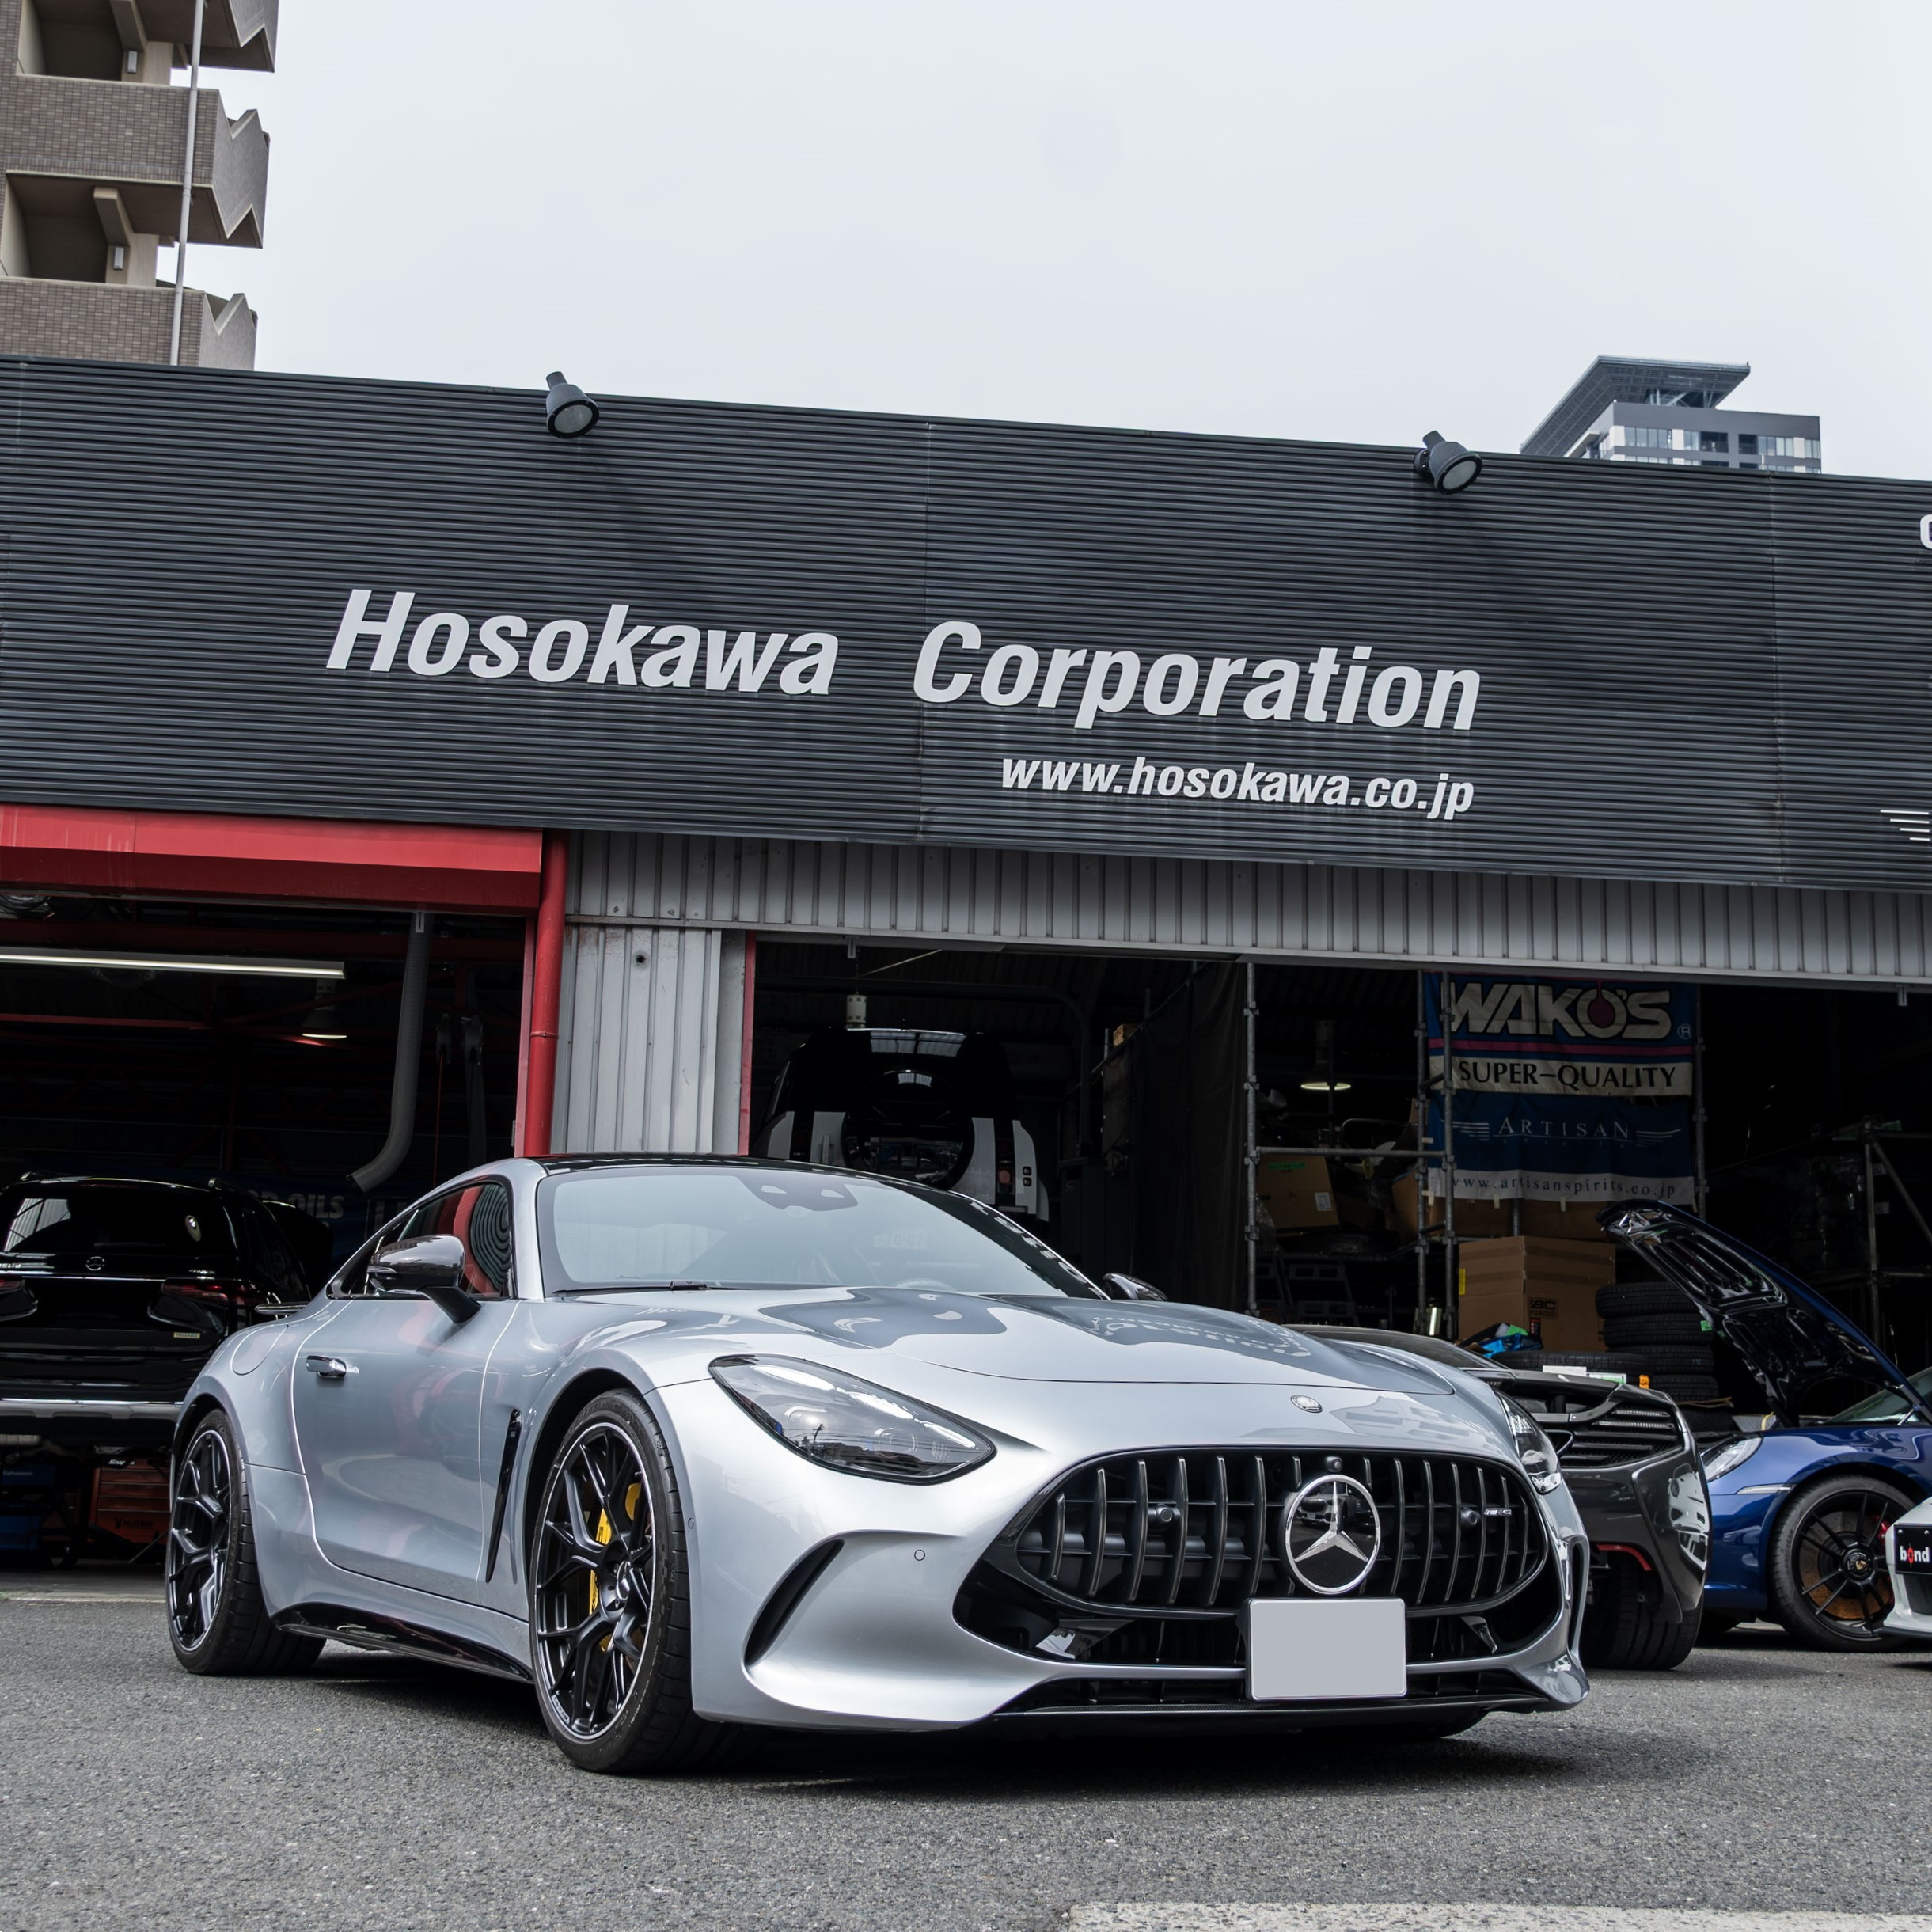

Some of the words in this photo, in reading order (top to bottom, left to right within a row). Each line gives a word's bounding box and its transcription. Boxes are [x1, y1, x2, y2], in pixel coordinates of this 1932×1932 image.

[326, 589, 838, 695] Hosokawa
[913, 621, 1480, 730] Corporation
[1002, 757, 1474, 820] www.hosokawa.co.jp
[1441, 981, 1672, 1040] WAKO'S
[1459, 1061, 1676, 1091] SUPER-QUALITY
[1498, 1117, 1628, 1139] ARTISAN
[1900, 1545, 1930, 1564] bond
